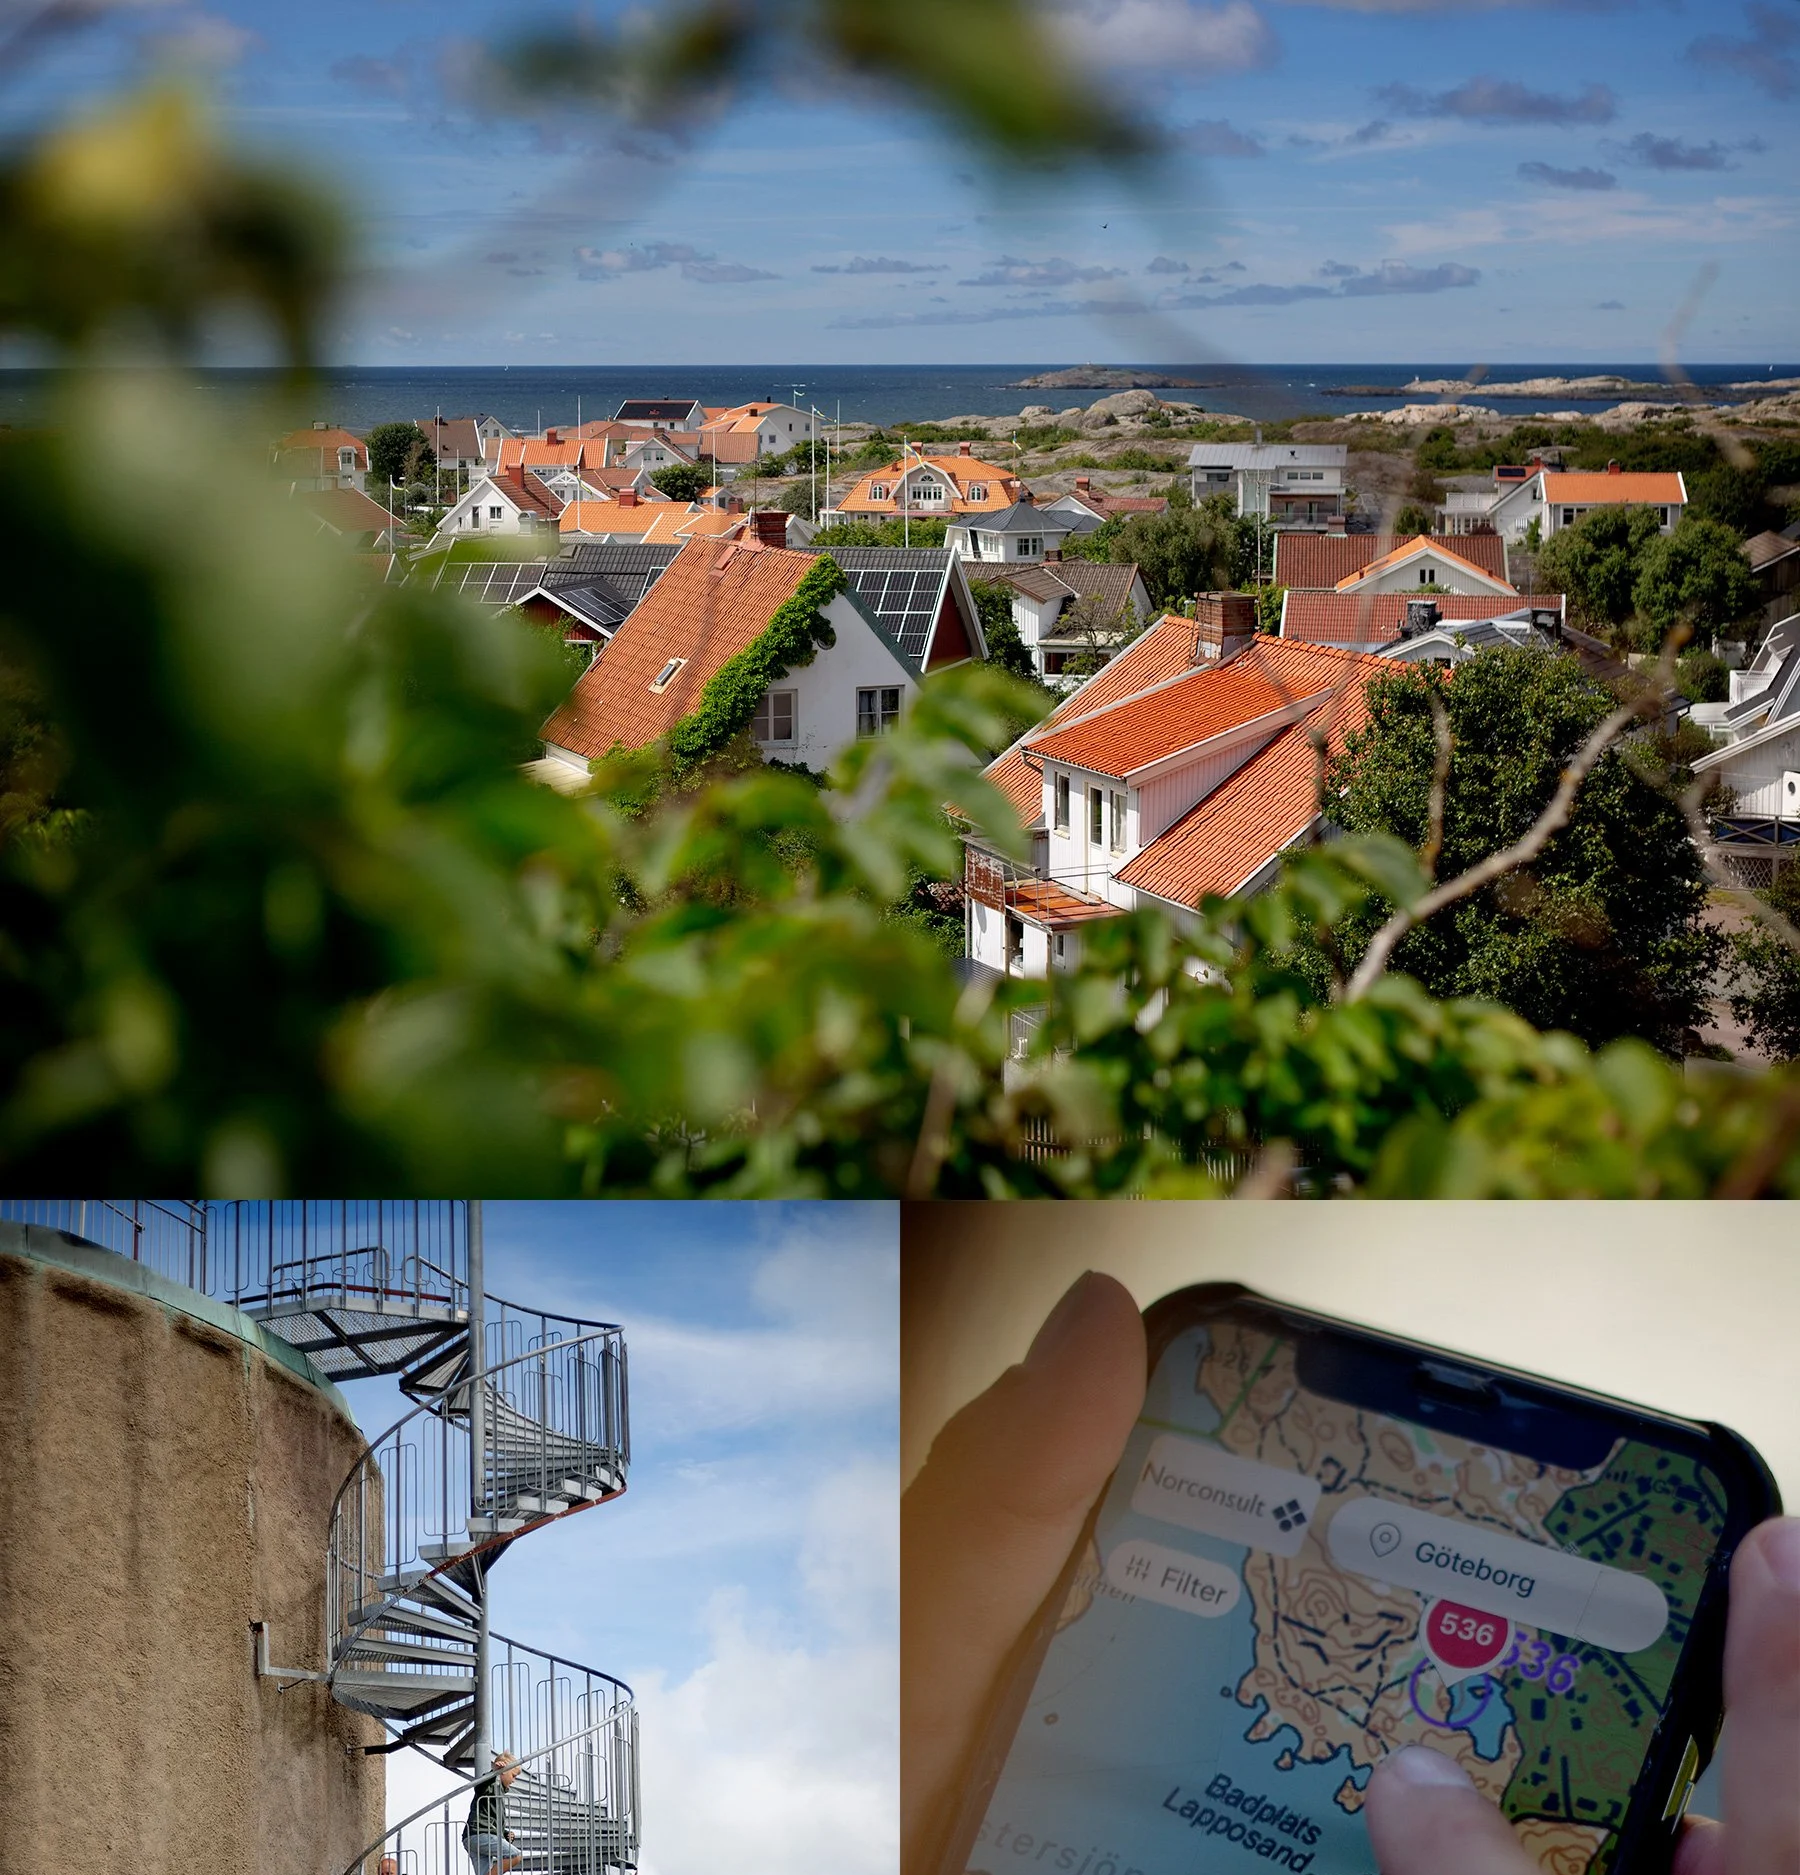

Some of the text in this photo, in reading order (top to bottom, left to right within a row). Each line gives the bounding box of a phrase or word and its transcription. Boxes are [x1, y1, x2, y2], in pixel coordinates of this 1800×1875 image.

[1142, 1461, 1266, 1517] Norconsult
[1160, 1567, 1228, 1605] Filter
[1415, 1542, 1535, 1598] Göteborg
[1439, 1612, 1496, 1646] 536
[1163, 1786, 1316, 1874] Lapposand
[1205, 1773, 1323, 1846] Badplats
